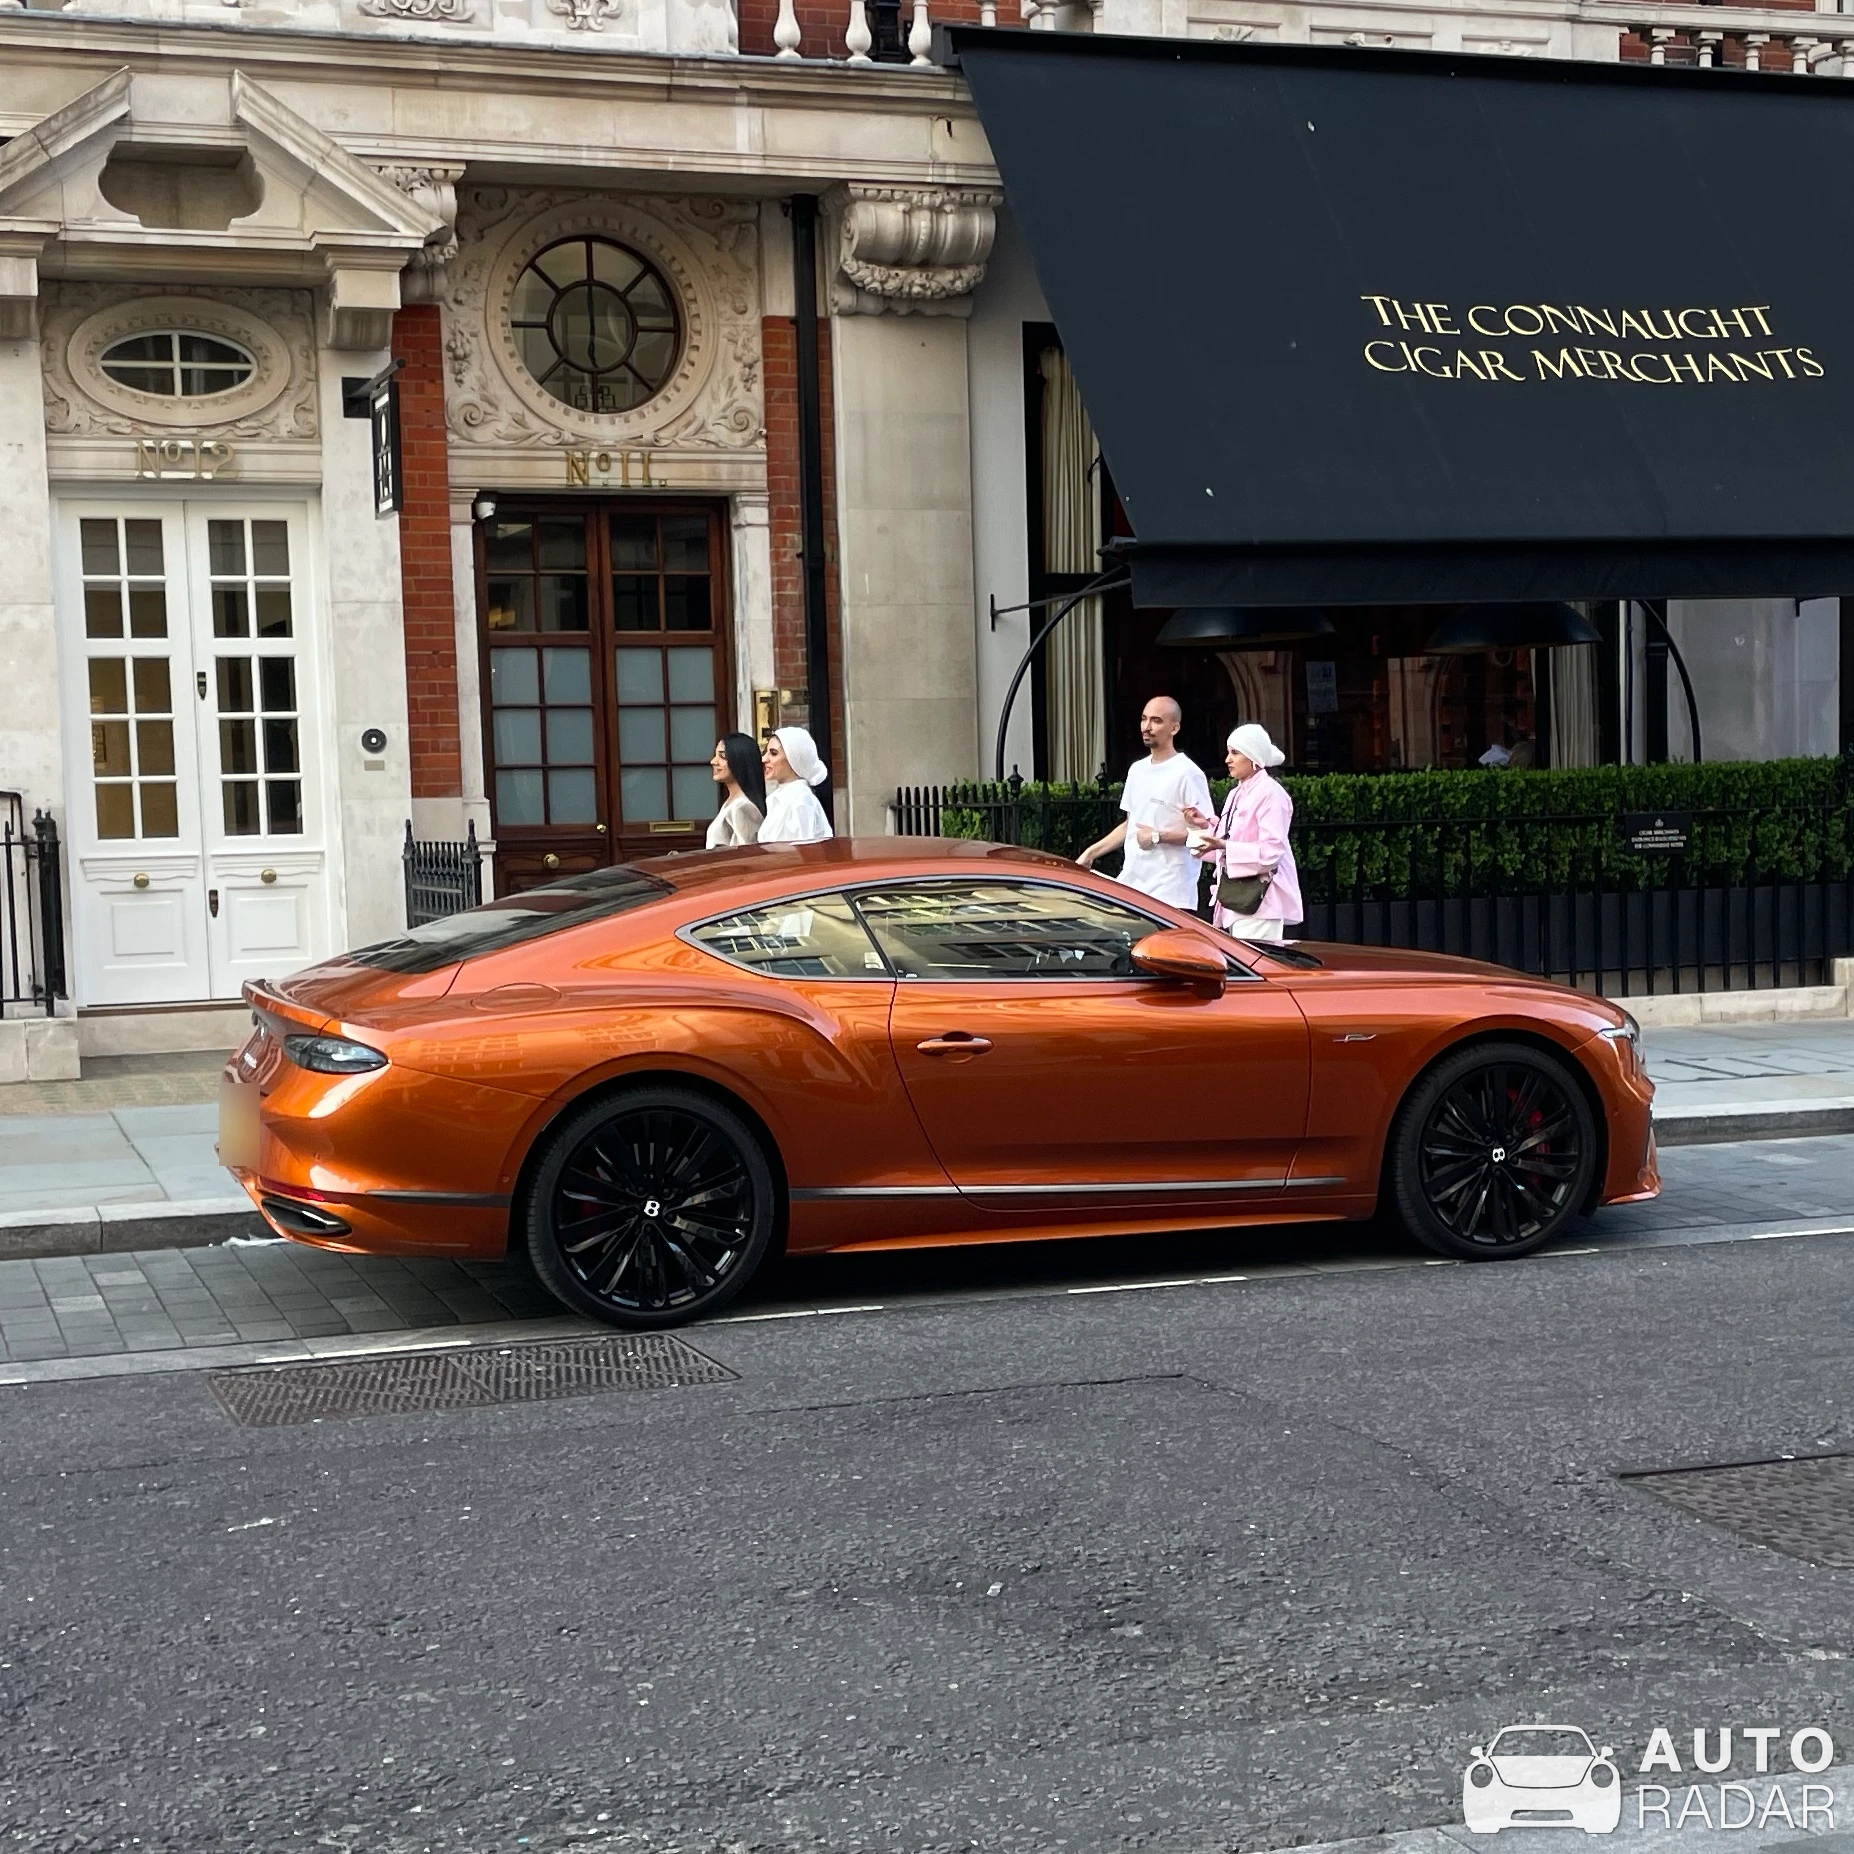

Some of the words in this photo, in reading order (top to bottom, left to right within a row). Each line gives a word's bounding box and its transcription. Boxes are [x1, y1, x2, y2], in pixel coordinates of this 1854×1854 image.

[1360, 295, 1461, 335] THE
[1467, 304, 1774, 340] CONNAUGHT
[1364, 341, 1526, 382] CIGAR
[1530, 348, 1825, 384] MERCHANTS
[643, 1200, 660, 1217] B
